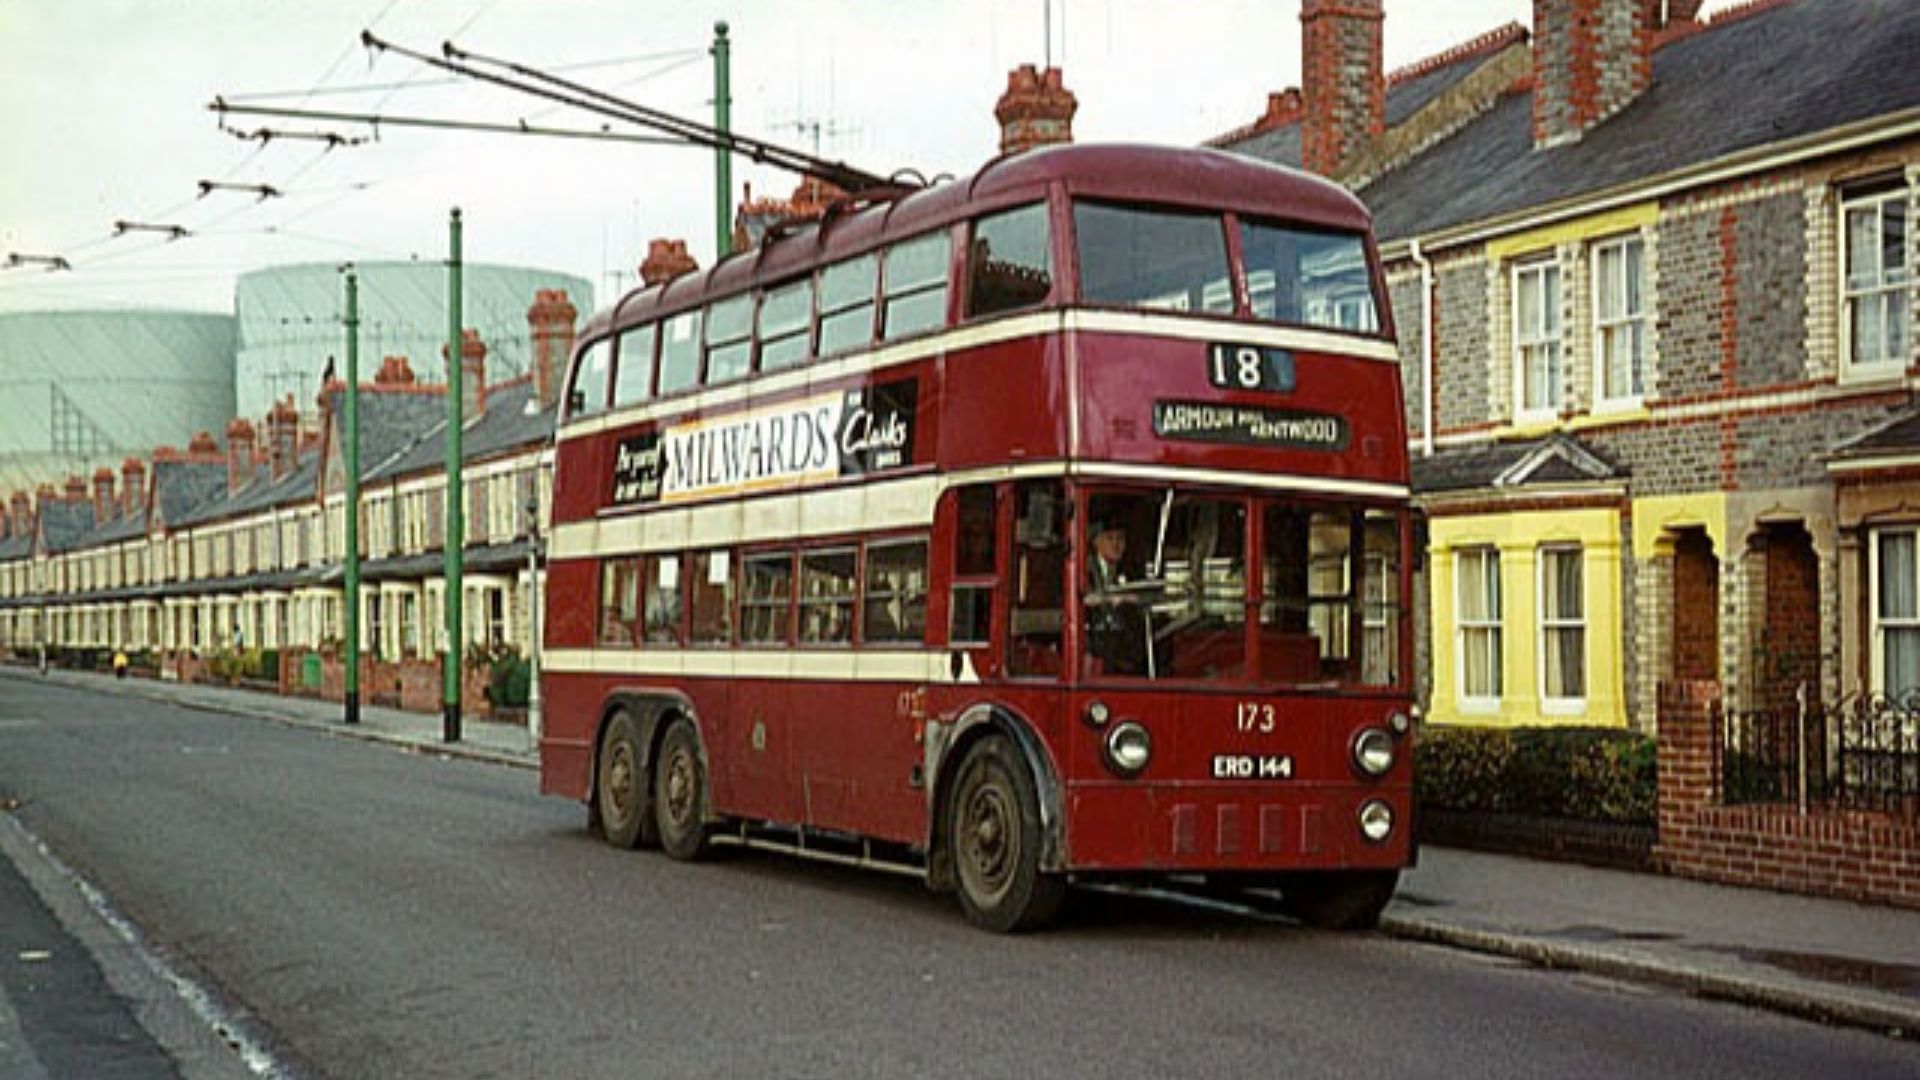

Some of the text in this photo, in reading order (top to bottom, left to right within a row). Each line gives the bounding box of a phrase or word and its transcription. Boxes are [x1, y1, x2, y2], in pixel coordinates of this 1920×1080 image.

[1213, 344, 1261, 387] 18
[1163, 404, 1234, 432] ARMOUR
[669, 407, 829, 491] MILWARDS
[1238, 702, 1275, 732] 173
[1259, 755, 1292, 778] 144
